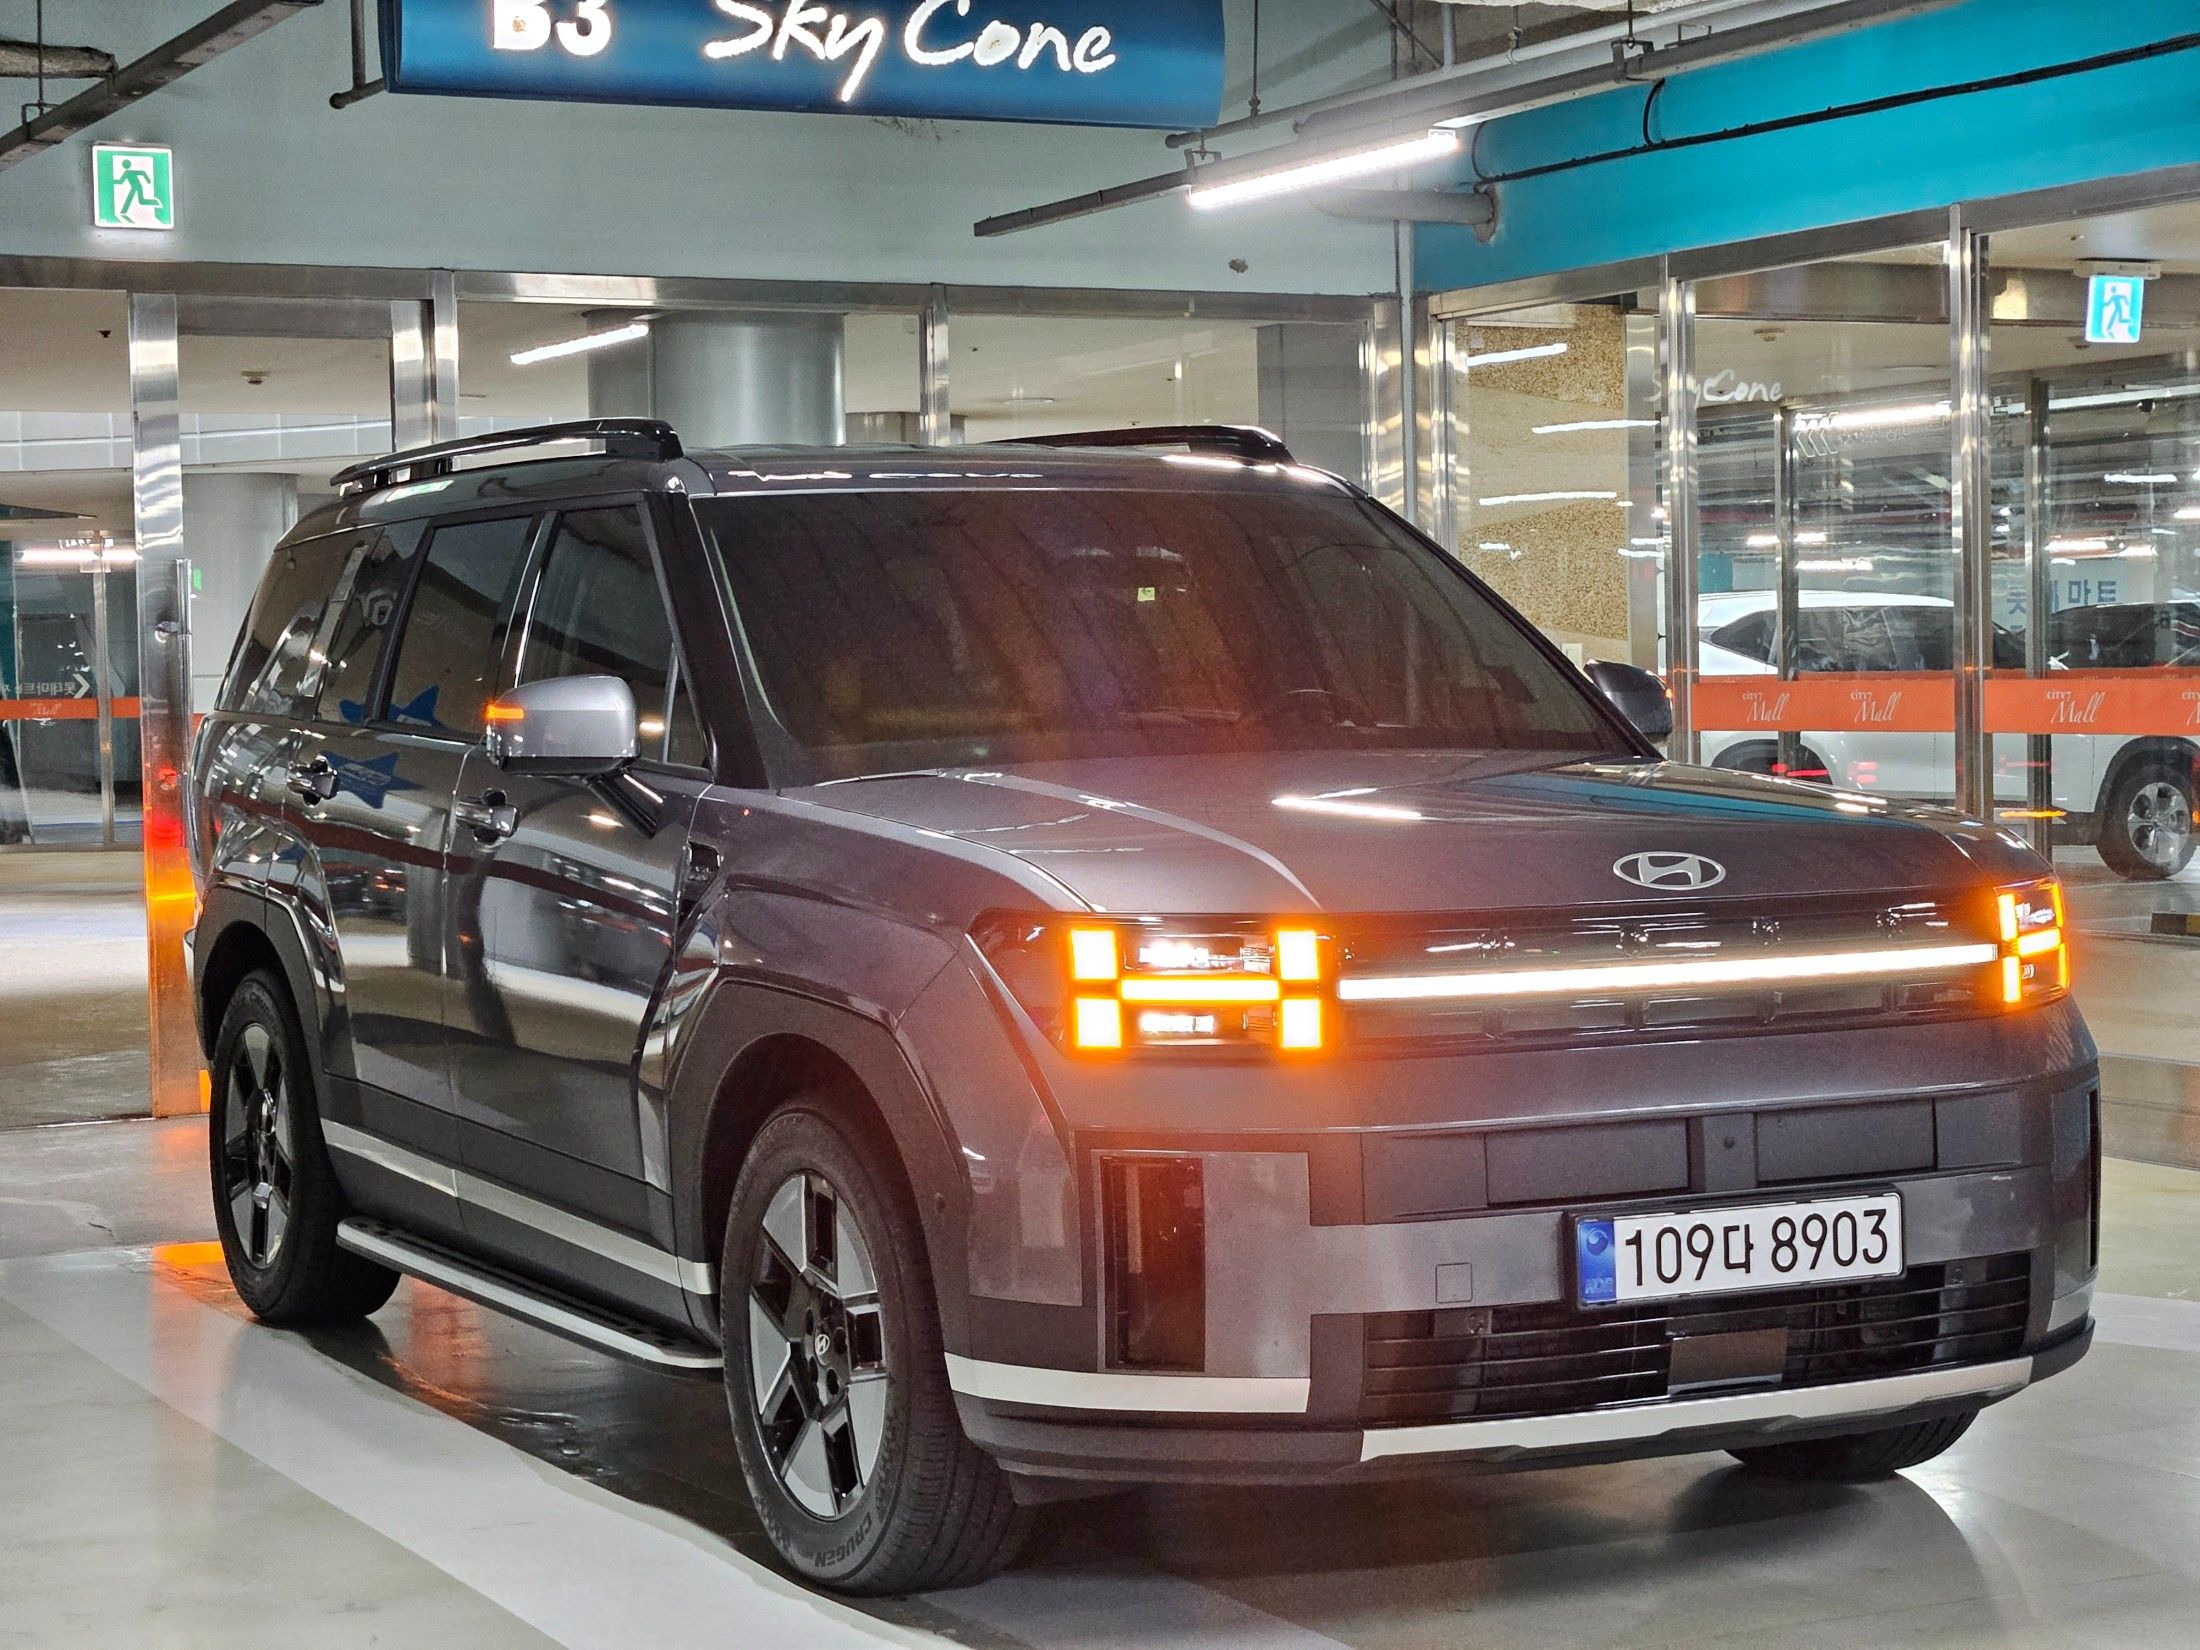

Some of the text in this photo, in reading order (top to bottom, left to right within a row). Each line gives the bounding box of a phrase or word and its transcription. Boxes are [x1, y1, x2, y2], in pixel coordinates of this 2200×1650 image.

[491, 0, 1117, 102] B3 Sky Cone
[1703, 368, 1783, 401] Cone
[1746, 692, 1790, 723] Mall
[1854, 692, 1902, 724] Mall
[2051, 692, 2106, 724] Mall
[1625, 1208, 1889, 1287] 109다 8903
